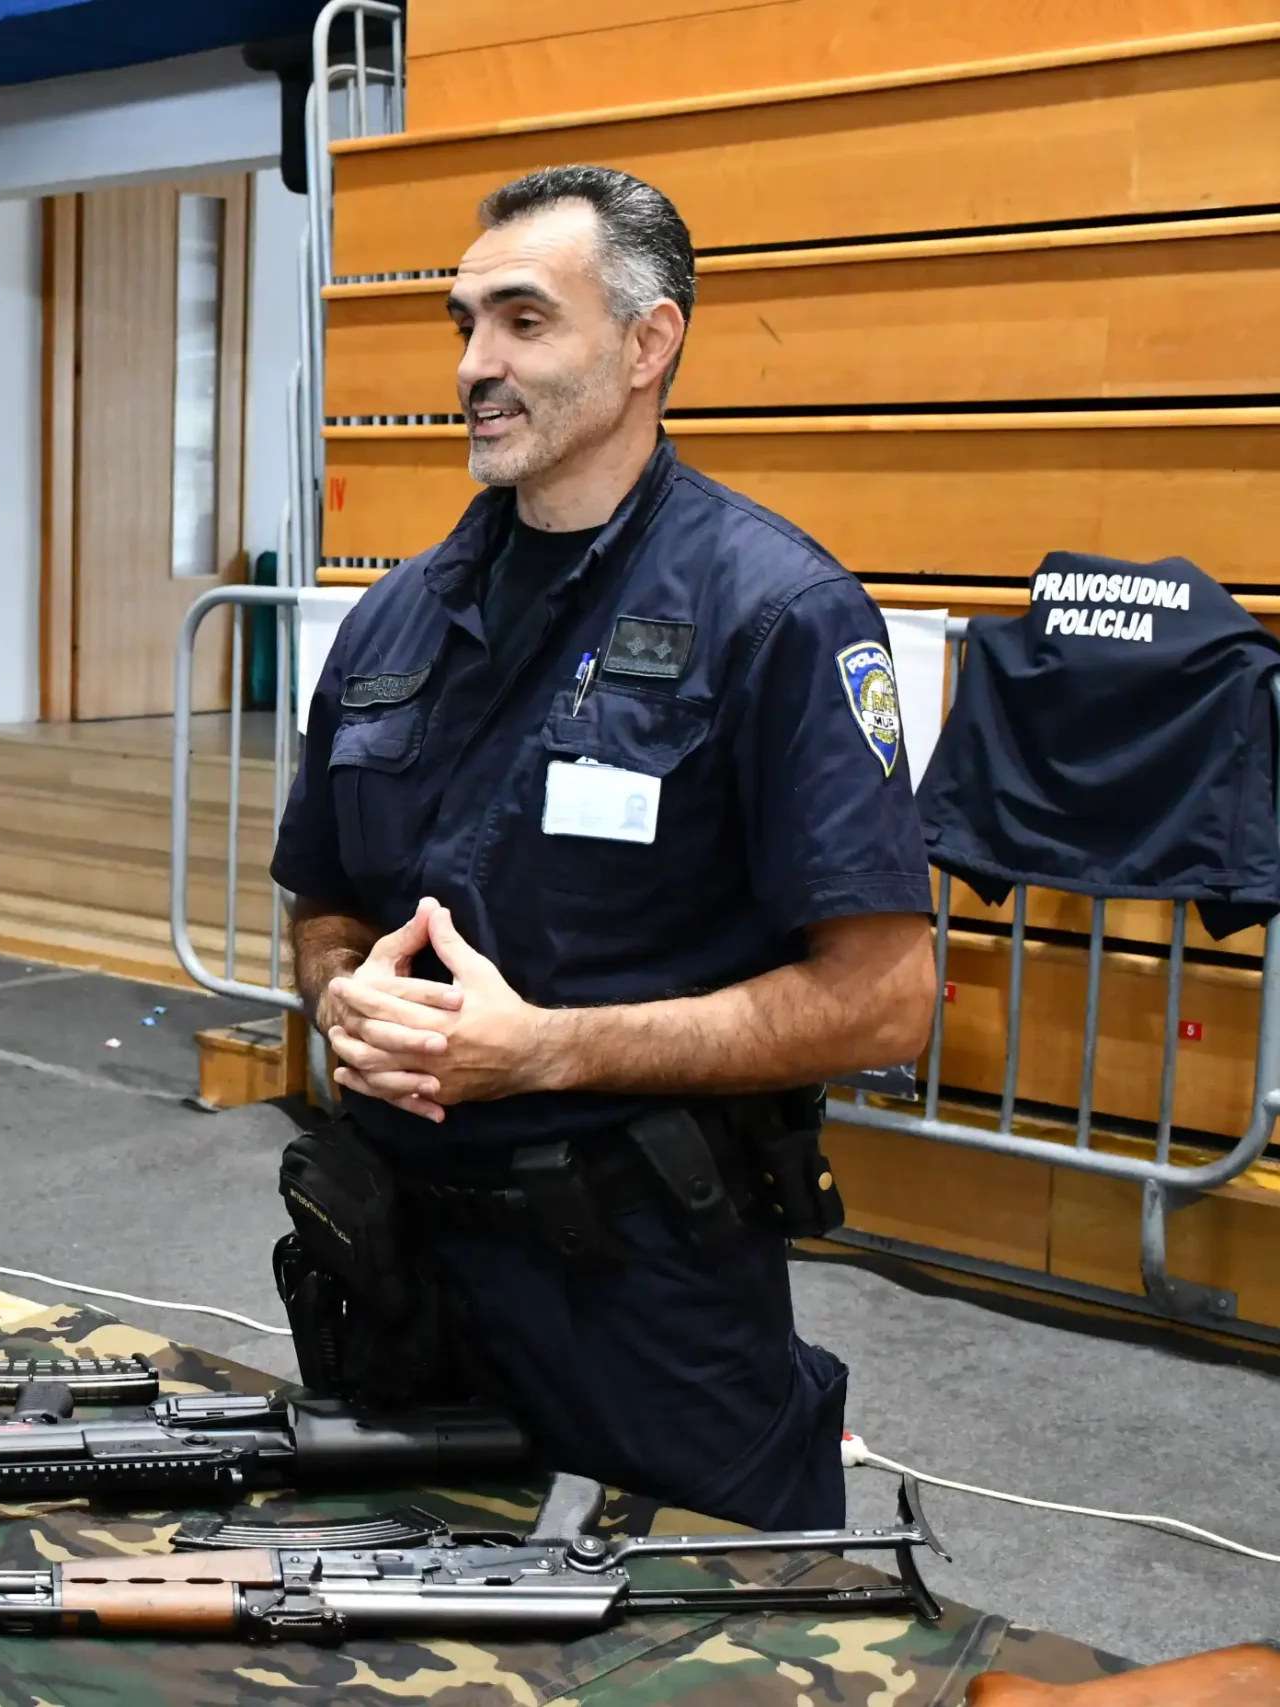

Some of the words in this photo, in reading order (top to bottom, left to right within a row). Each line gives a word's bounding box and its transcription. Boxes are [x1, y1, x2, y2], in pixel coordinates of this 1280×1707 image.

[329, 477, 346, 512] IV
[1031, 572, 1190, 610] PRAVOSUDNA
[1045, 608, 1154, 642] POLICIJA
[873, 715, 894, 728] MUP
[1187, 1024, 1195, 1036] 5
